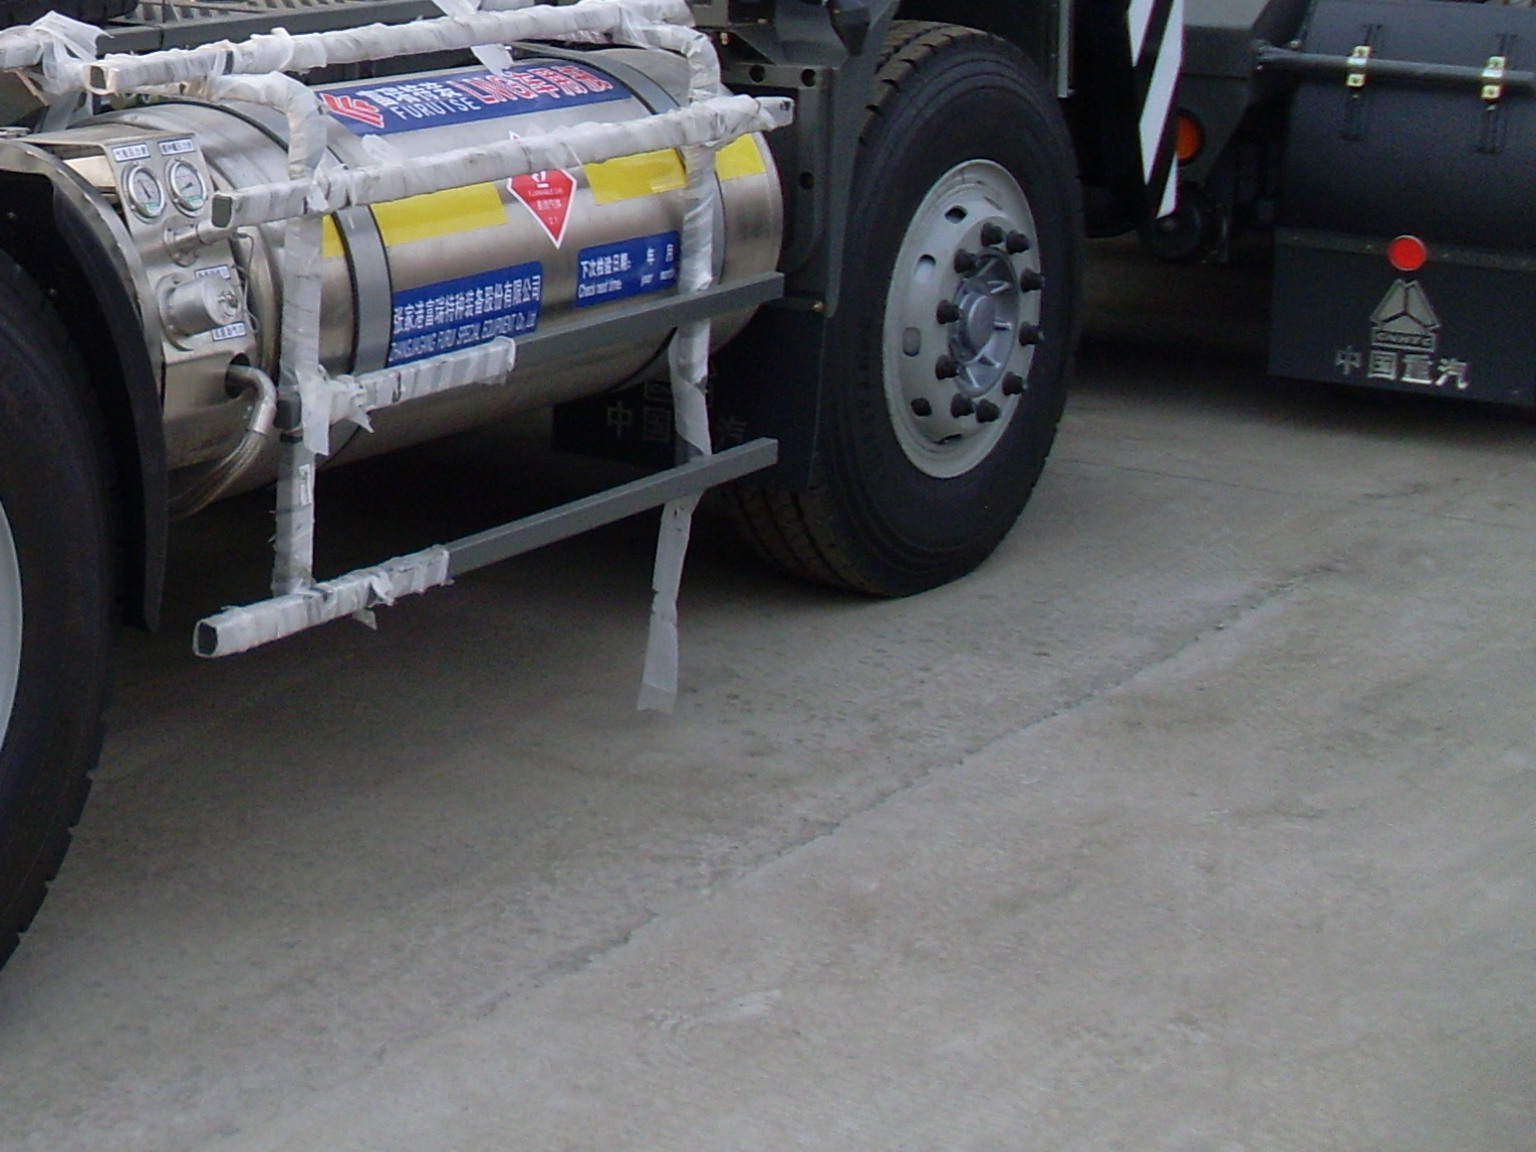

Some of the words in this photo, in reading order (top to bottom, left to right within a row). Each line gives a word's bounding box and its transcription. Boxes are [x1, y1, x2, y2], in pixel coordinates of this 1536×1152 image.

[389, 96, 482, 121] FURUISE
[1335, 345, 1469, 390] 中国重汽
